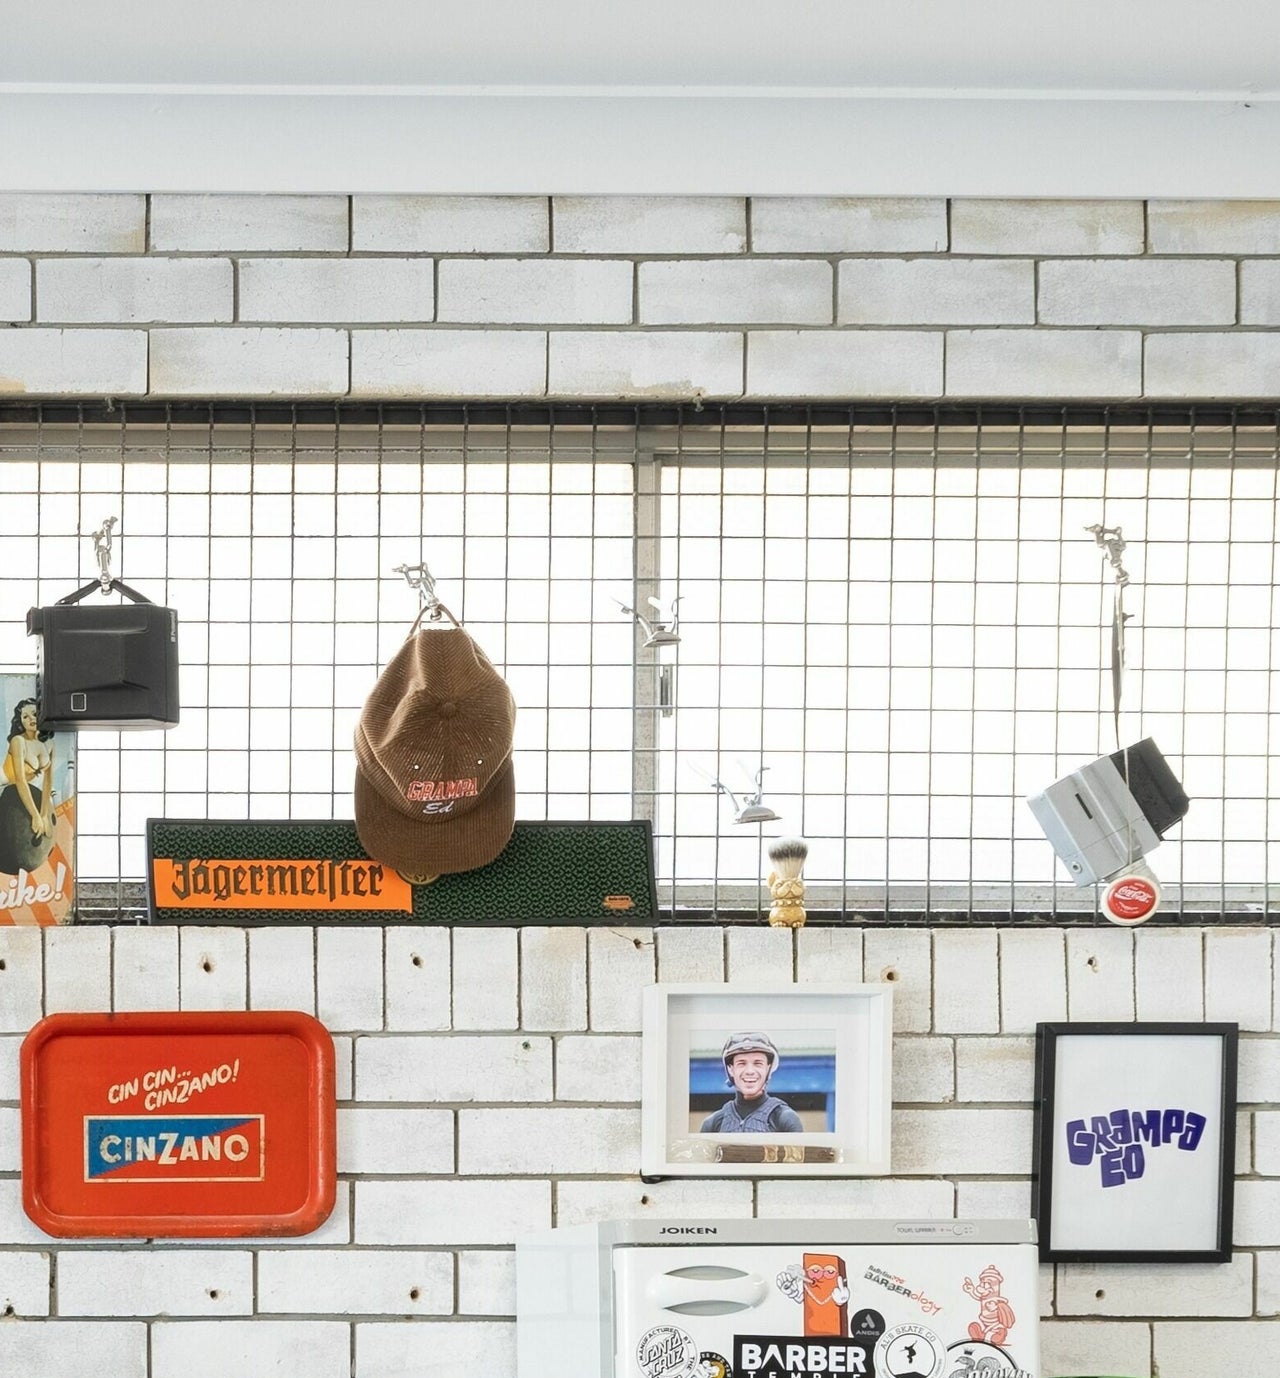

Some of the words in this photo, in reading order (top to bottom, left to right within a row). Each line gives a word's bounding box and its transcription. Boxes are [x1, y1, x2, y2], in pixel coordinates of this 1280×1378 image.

[406, 777, 479, 802] GRAMPA
[421, 800, 454, 816] Ed
[107, 1077, 139, 1105] CIN
[144, 1057, 240, 1111] CINZANO!
[99, 1132, 249, 1166] CINZANO
[658, 1227, 718, 1235] JOIKEN
[895, 1325, 925, 1335] SKATE
[642, 1329, 683, 1368] SANTA
[651, 1346, 685, 1378] CRUZ
[741, 1343, 867, 1374] BARBER
